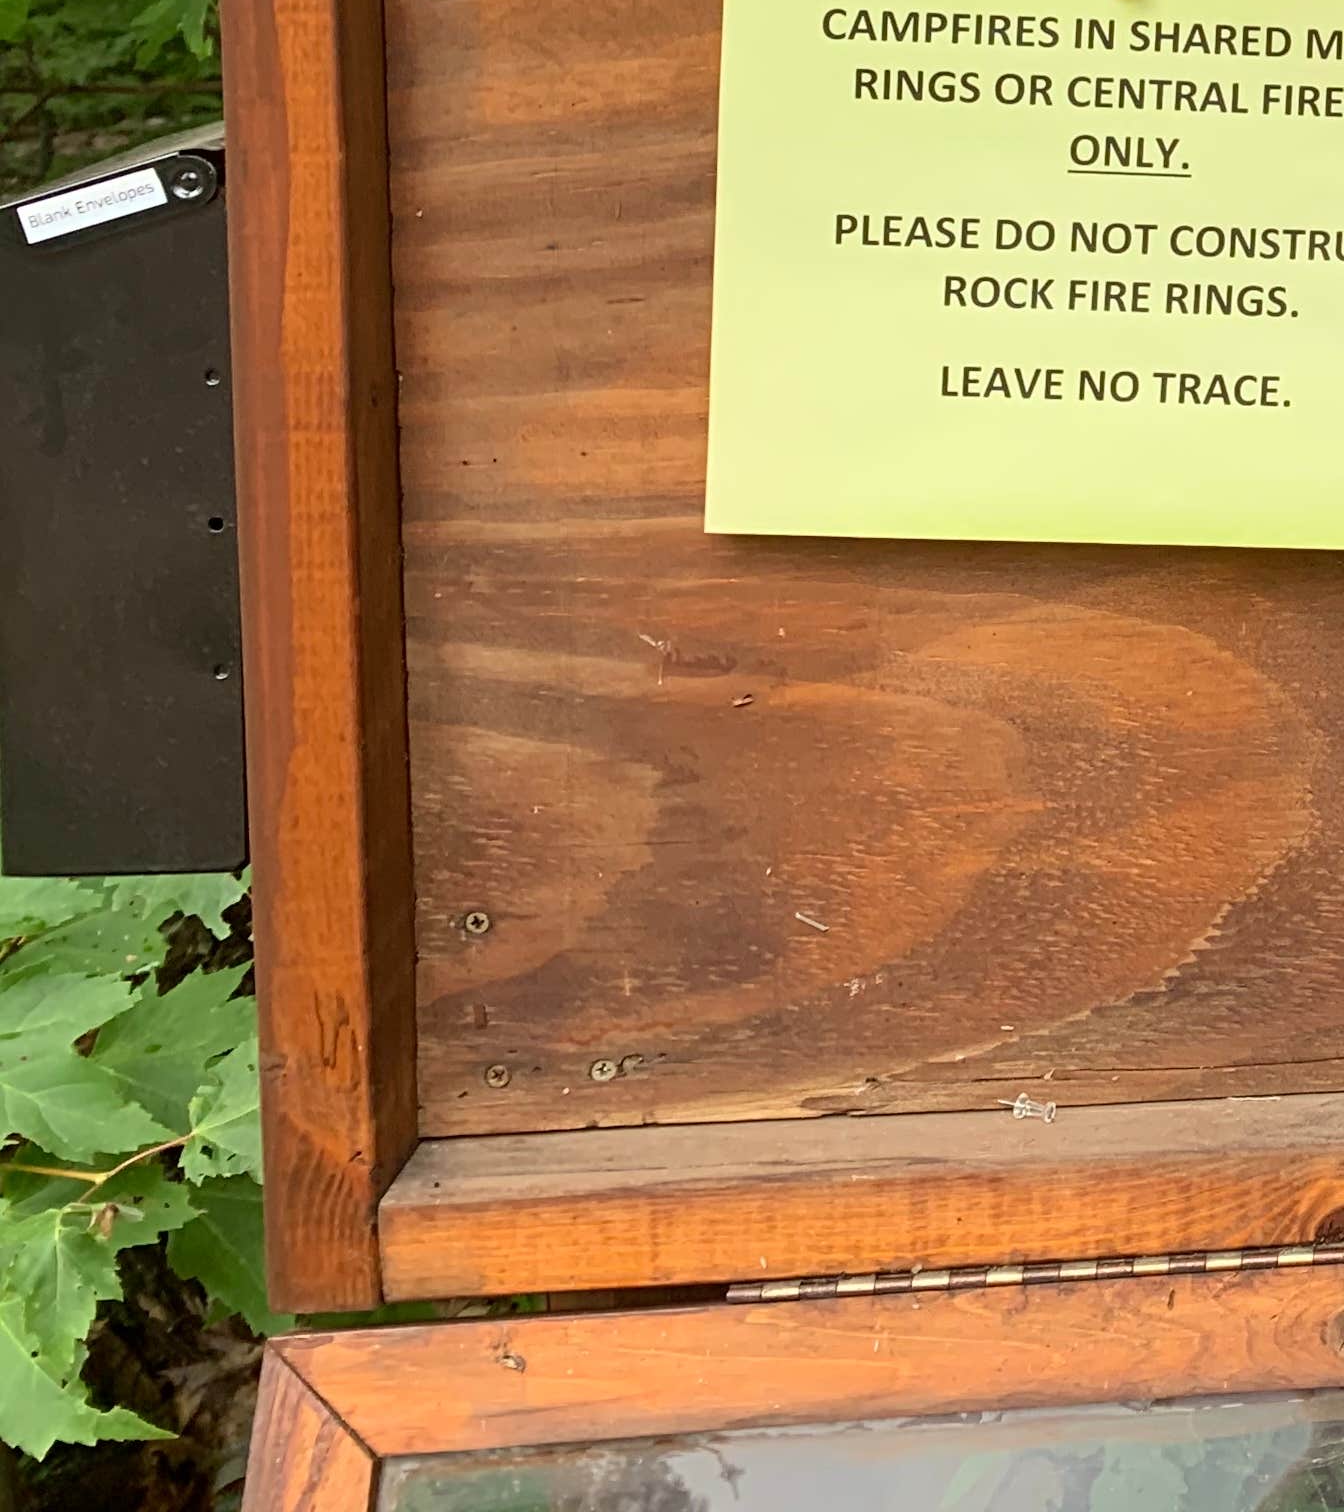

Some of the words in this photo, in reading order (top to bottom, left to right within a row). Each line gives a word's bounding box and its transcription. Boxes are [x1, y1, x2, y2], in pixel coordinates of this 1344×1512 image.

[822, 7, 1060, 49] CAMPFIRES
[1074, 17, 1116, 51] IN
[1129, 19, 1292, 58] SHARED
[854, 67, 981, 105] RINGS
[994, 72, 1053, 107] OR
[1067, 75, 1249, 115] CENTRAL
[1069, 133, 1190, 170] ONLY.
[28, 205, 73, 229] Blank
[75, 182, 155, 214] Envelopes
[835, 213, 981, 250] PLEASE
[995, 218, 1056, 253] DO
[1070, 220, 1159, 256] NOT
[943, 275, 1055, 311] ROCK
[1068, 278, 1152, 314] FIRE
[1165, 281, 1299, 319] RINGS.
[941, 365, 1065, 402] LEAVE
[1078, 369, 1140, 403] NO
[1152, 371, 1291, 408] TRACE.
